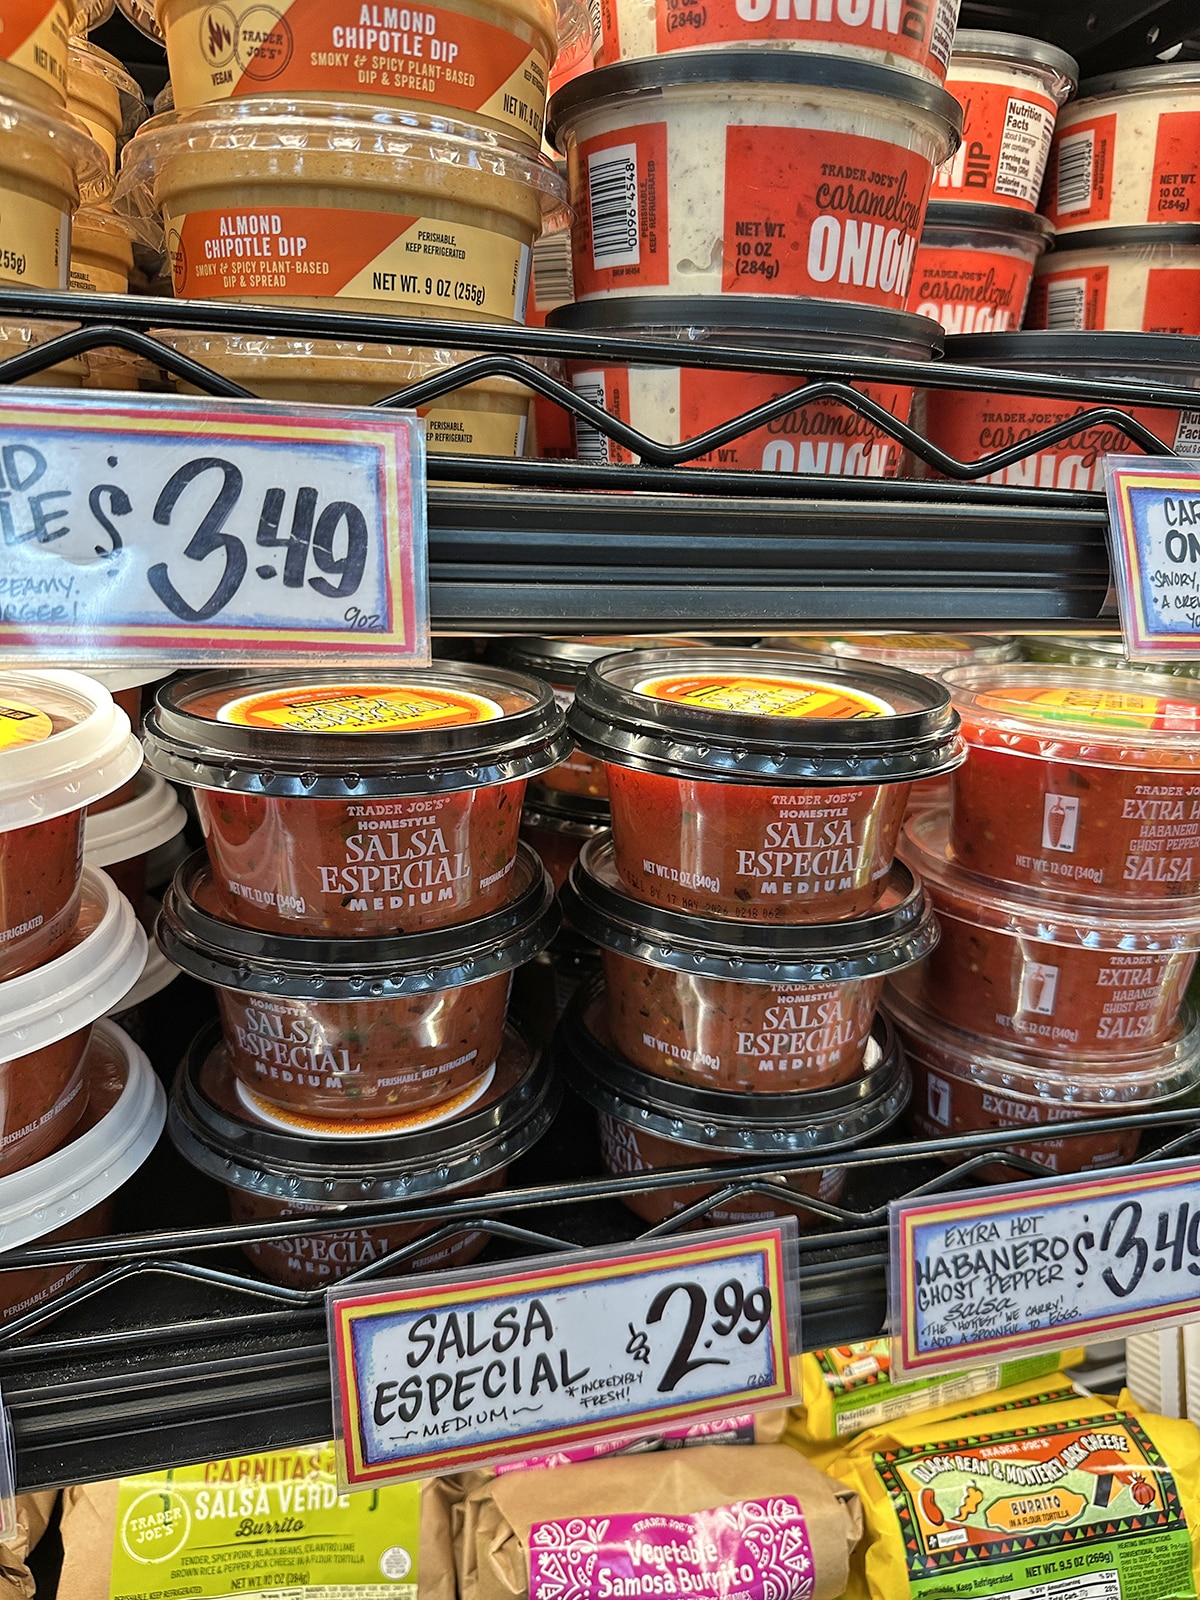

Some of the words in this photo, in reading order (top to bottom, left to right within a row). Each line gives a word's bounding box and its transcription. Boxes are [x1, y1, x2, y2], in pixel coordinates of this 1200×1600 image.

[359, 4, 436, 35] ALMOND
[666, 6, 707, 33] (284g)
[242, 30, 284, 46] TRADER
[332, 26, 423, 58] CHIPOTLE
[430, 41, 459, 64] DIP
[211, 69, 233, 87] VEGAN
[310, 52, 350, 67] SMOKY
[371, 56, 404, 73] SPICY
[407, 60, 476, 88] PLANT-BASED
[357, 69, 379, 84] DIP
[394, 73, 436, 93] SPREAD
[1006, 115, 1029, 132] Facts
[1008, 101, 1042, 123] Nutrition
[820, 163, 866, 182] TRADER
[965, 141, 990, 189] DIP
[1160, 174, 1179, 185] NET
[1159, 188, 1170, 198] 10
[1171, 187, 1185, 198] OZ
[816, 170, 926, 246] caramelized
[1158, 198, 1190, 212] (284g)
[219, 215, 282, 237] ALMOND
[735, 222, 765, 238] NET
[766, 223, 787, 239] WT.
[204, 237, 271, 260] CHIPOTLE
[278, 237, 307, 257] DIP
[417, 230, 456, 247] PERISHABLE,
[735, 242, 750, 257] 10
[754, 242, 772, 257] OZ
[405, 242, 421, 254] KEEP
[423, 244, 466, 260] REFRIGERATED
[807, 215, 916, 298] ONION
[195, 263, 217, 277] SMOKY
[231, 261, 257, 275] SPICY
[259, 261, 330, 275] PLANT-BASED
[734, 260, 779, 279] (284g)
[923, 269, 958, 279] TRADER
[249, 274, 287, 288] SPREAD
[372, 272, 397, 292] NET
[400, 274, 421, 294] WT.
[425, 277, 432, 296] 9
[436, 279, 451, 299] OZ
[454, 281, 486, 305] (255g)
[430, 421, 465, 433] PERISHABLE,
[982, 413, 1026, 423] TRADER
[435, 432, 473, 443] REFRIGERATED
[718, 449, 738, 463] WT.
[1154, 569, 1200, 593] SAVORY,
[1161, 594, 1170, 609] A
[771, 794, 822, 806] TRADER
[1134, 785, 1183, 797] TRADER
[347, 803, 404, 818] TRADER
[406, 799, 444, 814] JOE'S
[779, 807, 849, 819] HOMESTYLE
[1120, 798, 1183, 820] EXTRA
[358, 815, 437, 831] HOMESTYLE
[764, 819, 855, 849] SALSA
[1139, 823, 1198, 837] HABANERO
[345, 827, 450, 864] SALSA
[1129, 838, 1165, 852] GHOST
[317, 851, 471, 895] ESPECIAL
[736, 845, 869, 879] ESPECIAL
[1015, 854, 1031, 868] NET
[1060, 864, 1073, 877] OZ
[1074, 865, 1103, 884] (340g)
[1123, 855, 1193, 882] SALSA
[643, 859, 655, 874] NET
[671, 869, 679, 882] 12
[680, 872, 692, 886] OZ
[692, 874, 720, 893] (340g)
[760, 879, 853, 895] MEDIUM
[228, 879, 244, 894] NET
[263, 890, 275, 907] OZ
[277, 891, 306, 914] (340g)
[350, 886, 454, 912] MEDIUM
[1096, 968, 1152, 986] EXTRA
[777, 990, 839, 1004] HOMESTYLE
[1103, 1002, 1134, 1014] GHOST
[244, 1007, 333, 1046] SALSA
[763, 1001, 844, 1031] SALSA
[1096, 1015, 1158, 1040] SALSA
[235, 1024, 361, 1075] ESPECIAL
[643, 1033, 657, 1046] NET
[680, 1047, 692, 1061] OZ
[736, 1021, 855, 1057] ESPECIAL
[377, 1068, 421, 1087] PERISHABLE,
[422, 1063, 439, 1079] KEEP
[438, 1049, 478, 1076] REFRIGERATED
[759, 1051, 841, 1071] MEDIUM
[255, 1061, 343, 1089] MEDIUM
[982, 1093, 1040, 1121] EXTRA
[944, 1221, 1001, 1249] EXTRA
[1010, 1215, 1045, 1237] HOT
[916, 1236, 1069, 1286] HABANERO
[3, 1290, 49, 1318] PERISHABLE,
[50, 1276, 65, 1293] KEEP
[917, 1275, 981, 1312] GHOST
[986, 1264, 1064, 1295] PEPPER
[1025, 1295, 1064, 1318] CARRY!
[406, 1299, 554, 1368] SALSA
[970, 1326, 1023, 1342] SPOONFUL
[1027, 1320, 1040, 1330] TO
[1049, 1306, 1082, 1326] EGGS.
[373, 1348, 590, 1427] ESPECIAL
[580, 1386, 632, 1408] FRESH!
[912, 1455, 955, 1484] BLACK
[954, 1455, 990, 1477] BEAN
[992, 1461, 1004, 1481] &
[1006, 1457, 1068, 1487] MONTEREY
[1059, 1441, 1089, 1471] JACK
[1078, 1433, 1130, 1453] CHEESE
[979, 1443, 1020, 1458] TRADER
[204, 1453, 321, 1487] CARNITAS
[195, 1487, 271, 1520] SALSA
[280, 1481, 350, 1513] VERDE
[1010, 1494, 1062, 1516] BURRITO
[129, 1507, 183, 1532] TRADER
[235, 1517, 305, 1538] Burrito
[632, 1516, 668, 1533] TRADER
[135, 1524, 175, 1544] JOE'S
[624, 1538, 719, 1571] Vegetable
[1025, 1564, 1042, 1579] NET
[1074, 1557, 1085, 1569] OZ
[1086, 1551, 1114, 1567] (269g)
[231, 1574, 246, 1591] NET
[597, 1567, 677, 1598] Samosa
[676, 1559, 754, 1597] Burrito
[956, 1582, 973, 1594] Keep
[973, 1573, 1014, 1587] Refrigerated
